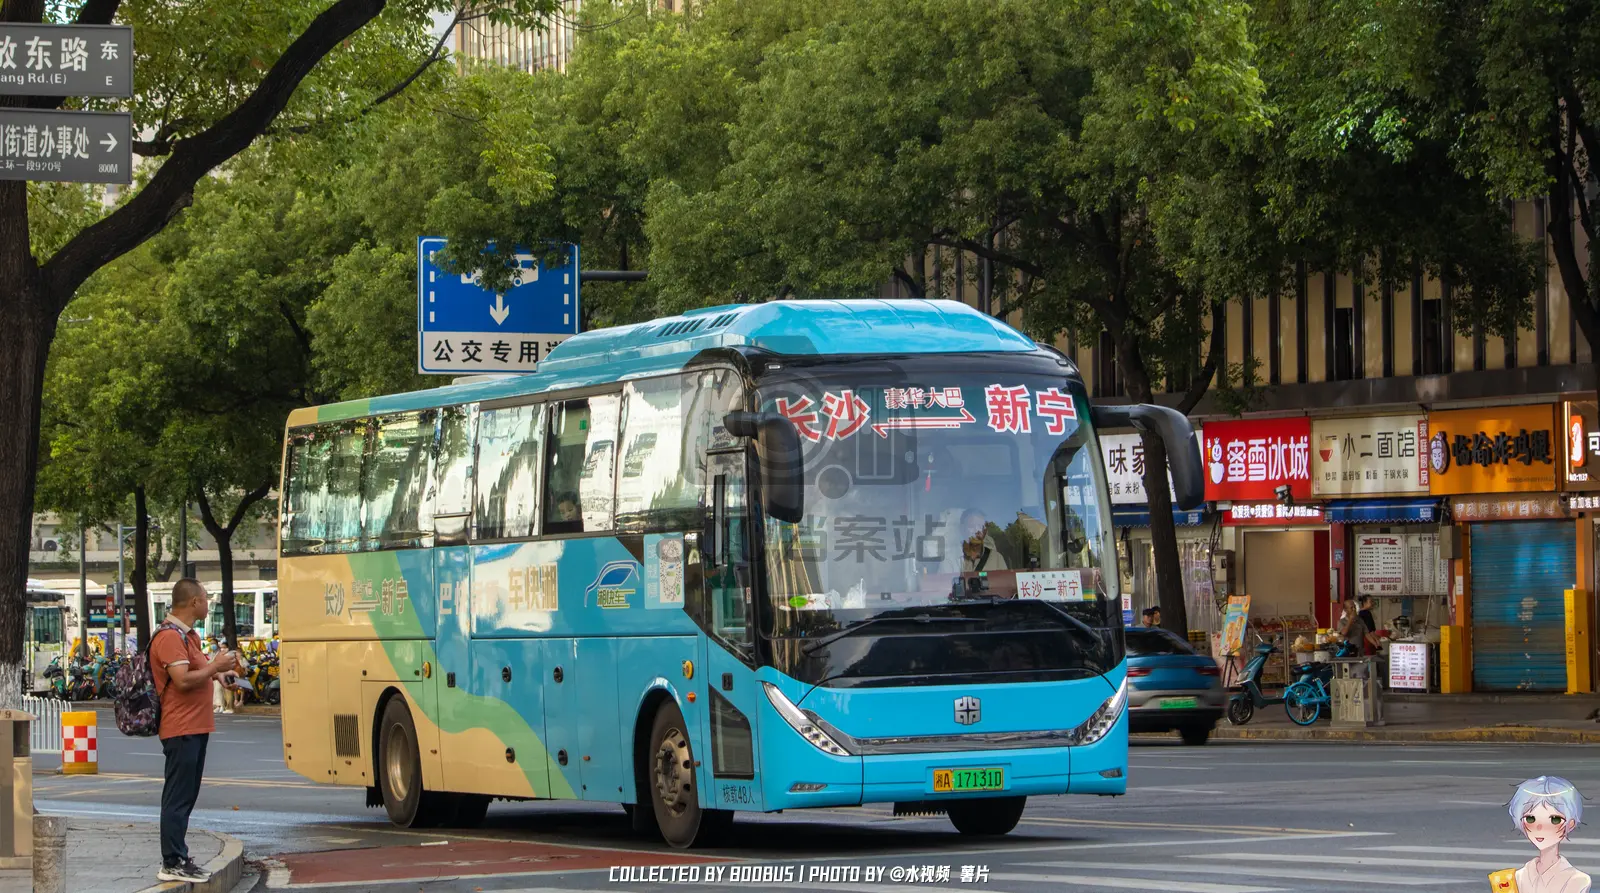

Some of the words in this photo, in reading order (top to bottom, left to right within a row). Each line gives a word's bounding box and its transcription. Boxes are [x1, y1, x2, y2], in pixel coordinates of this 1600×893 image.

[100, 40, 119, 61] 东
[27, 72, 67, 85] Rd.(E)
[105, 75, 113, 86] E
[98, 163, 118, 173] 800M
[884, 386, 965, 409] 豪华大巴
[775, 388, 872, 444] 长沙
[983, 383, 1078, 436] 新宁
[1342, 429, 1415, 461] 小二面馆
[1226, 435, 1309, 482] 蜜雪冰城
[935, 773, 951, 789] 湘A
[957, 771, 1002, 788] 17131D
